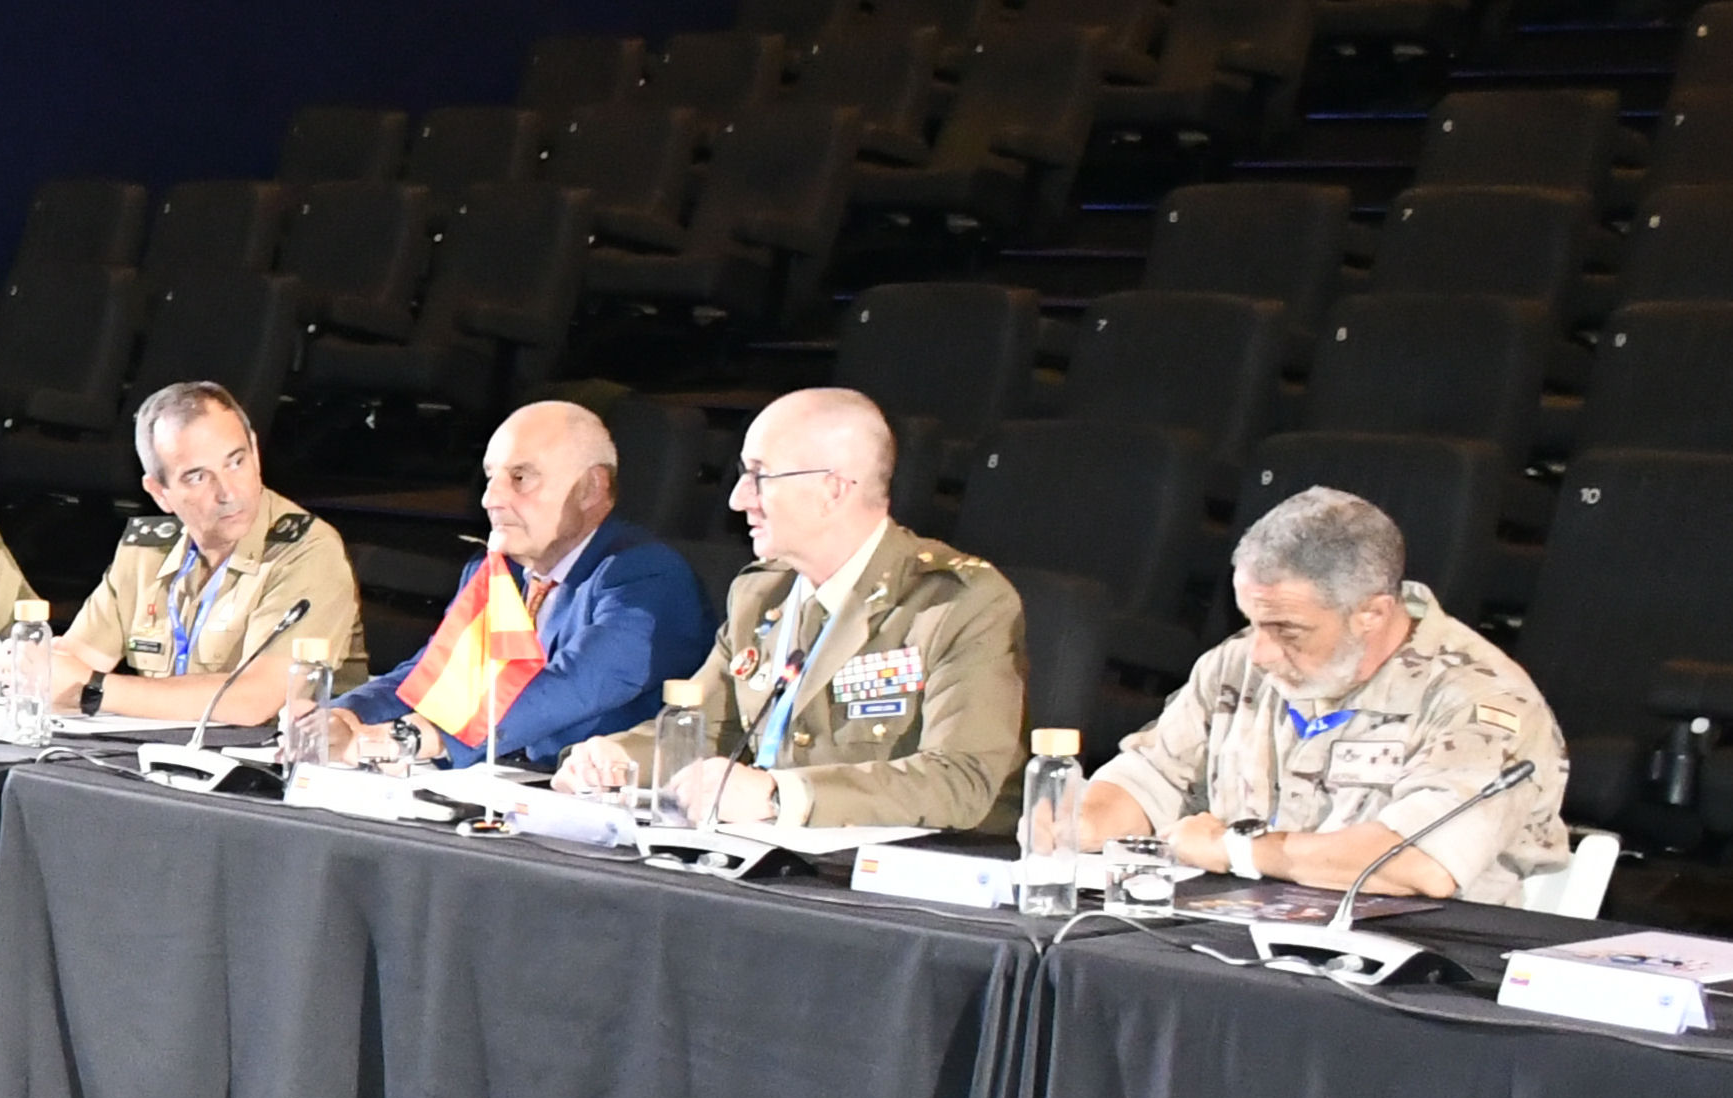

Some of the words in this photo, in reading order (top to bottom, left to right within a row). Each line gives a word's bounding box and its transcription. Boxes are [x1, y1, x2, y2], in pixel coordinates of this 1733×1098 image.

[1096, 319, 1108, 331] 7
[987, 454, 999, 468] 8
[1261, 470, 1273, 485] 9
[1581, 487, 1601, 504] 10
